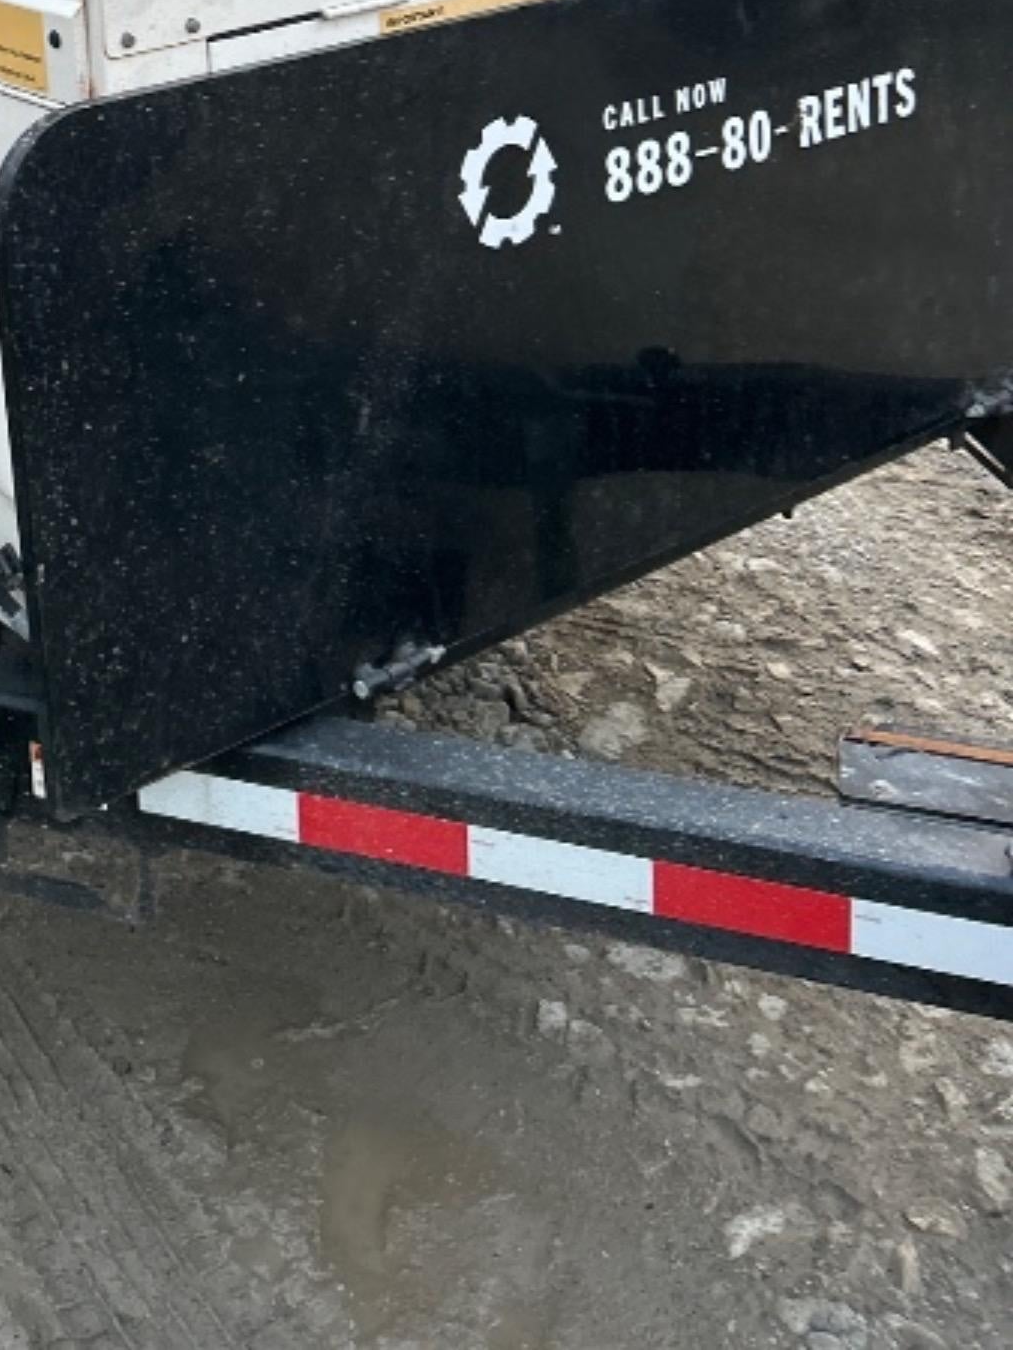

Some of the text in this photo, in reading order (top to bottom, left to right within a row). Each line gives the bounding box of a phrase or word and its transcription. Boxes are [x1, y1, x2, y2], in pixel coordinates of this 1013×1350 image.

[602, 77, 727, 131] CALL NOW
[604, 67, 916, 203] 888-80-RENTS
